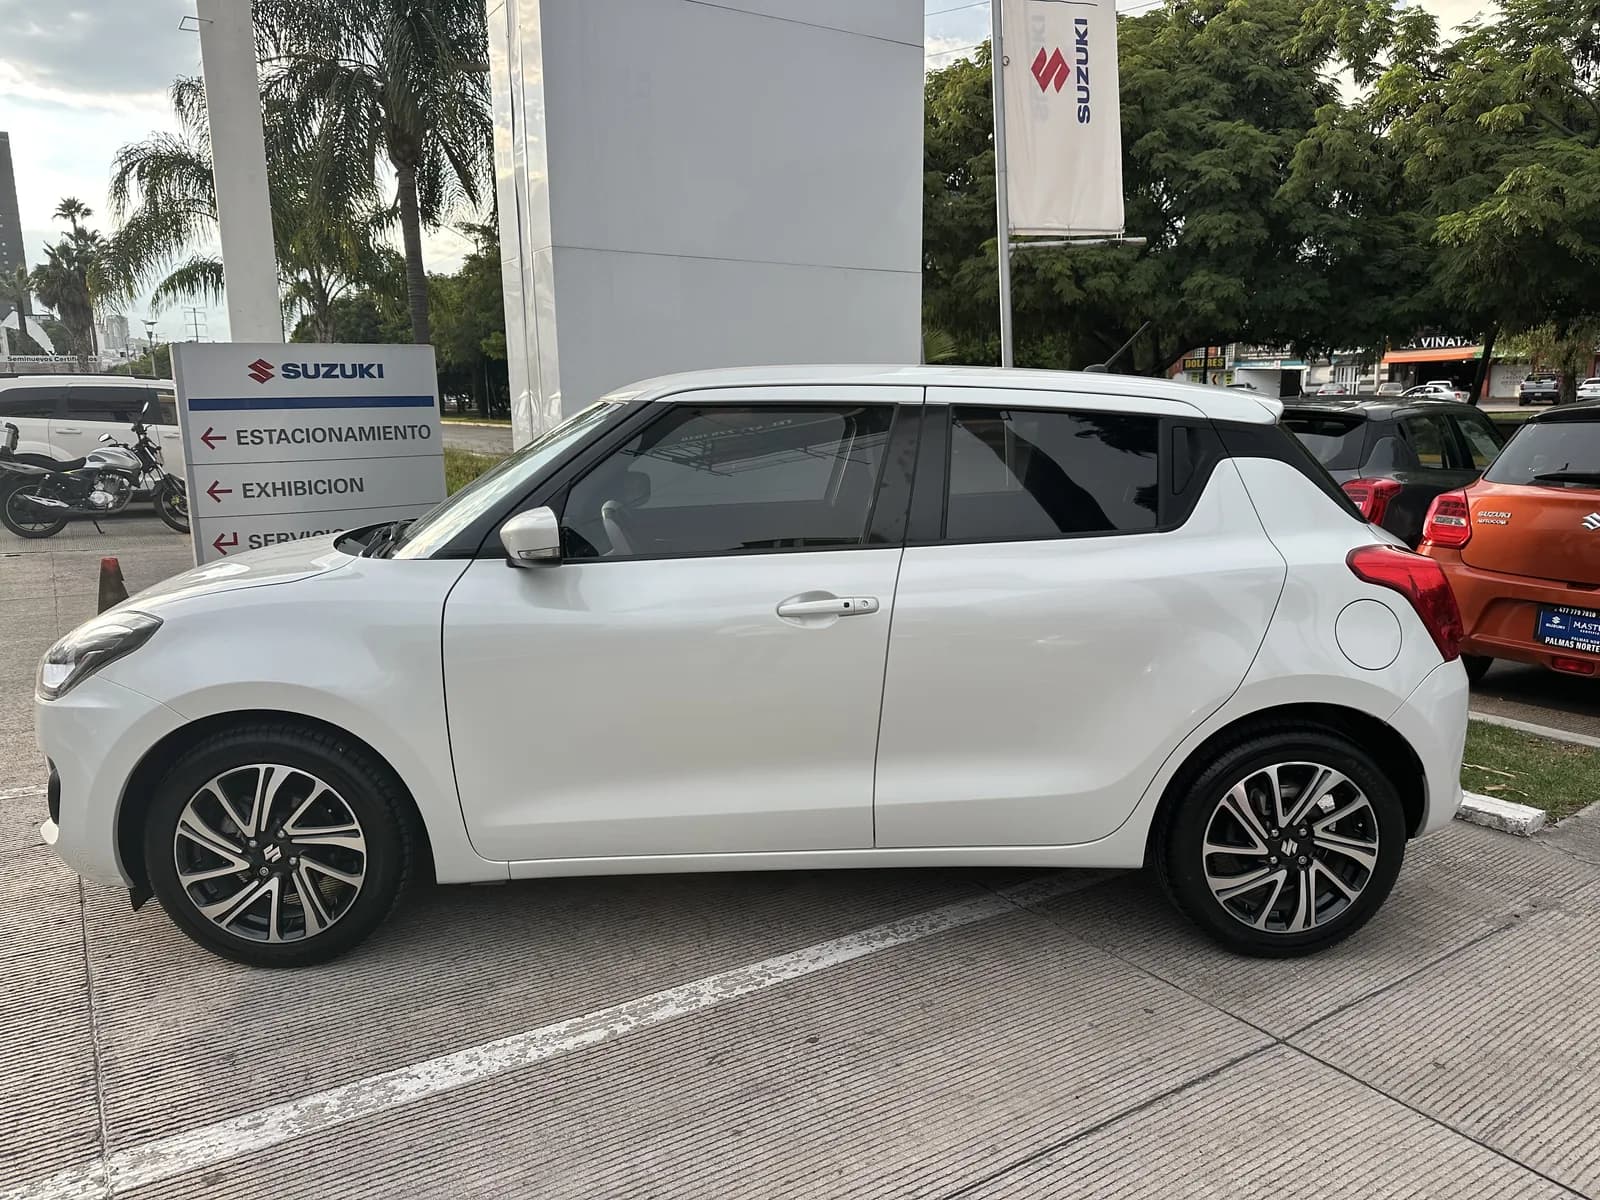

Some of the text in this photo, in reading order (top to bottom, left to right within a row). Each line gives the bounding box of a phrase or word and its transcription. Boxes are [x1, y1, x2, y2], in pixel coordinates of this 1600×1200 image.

[1074, 18, 1091, 124] SUZUKI
[281, 362, 385, 380] SUZUKI
[236, 424, 432, 446] ESTACIONAMIENTO
[242, 477, 365, 499] EXHIBICION
[1477, 511, 1512, 519] SUZUKI
[248, 528, 345, 550] SERV
[1544, 636, 1600, 653] PALMAS NORTE
